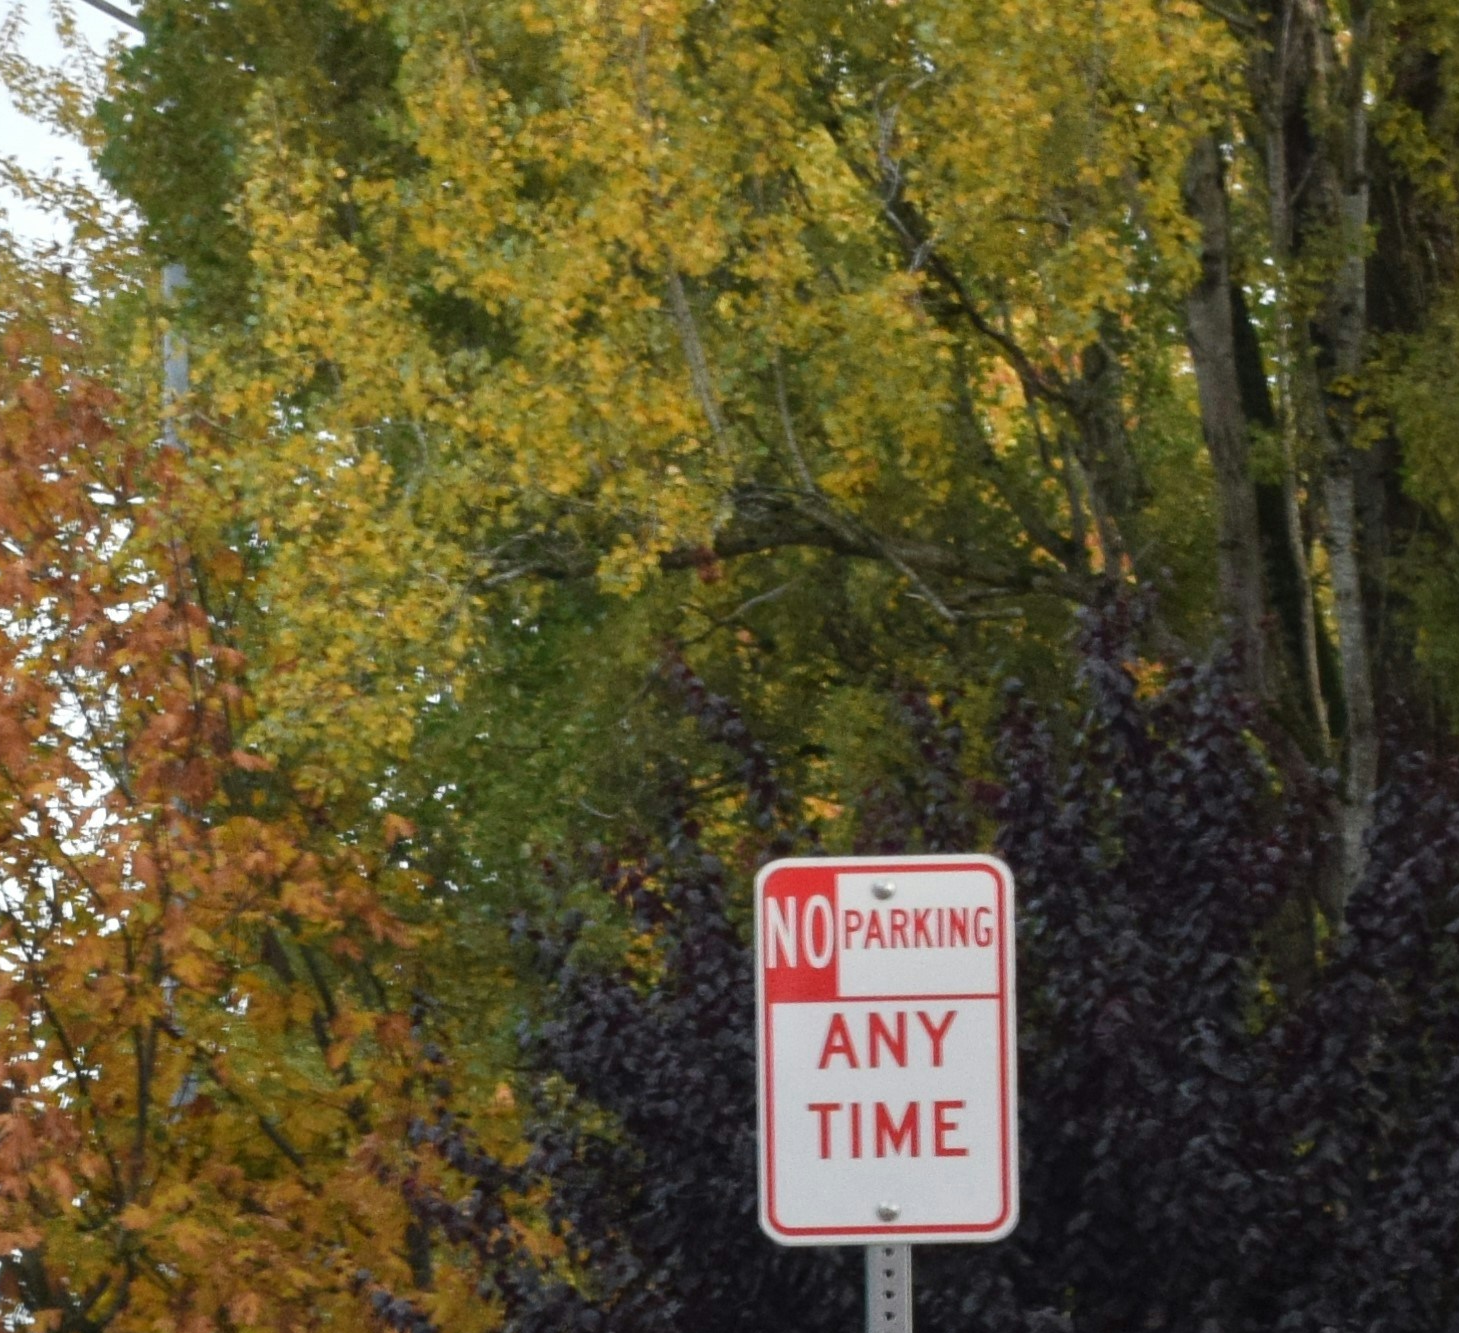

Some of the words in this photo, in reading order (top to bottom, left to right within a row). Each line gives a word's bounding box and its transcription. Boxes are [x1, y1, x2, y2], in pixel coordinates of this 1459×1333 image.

[764, 894, 835, 969] NO
[842, 906, 994, 949] PARKING
[818, 1010, 958, 1070] ANY
[807, 1101, 970, 1159] TIME
